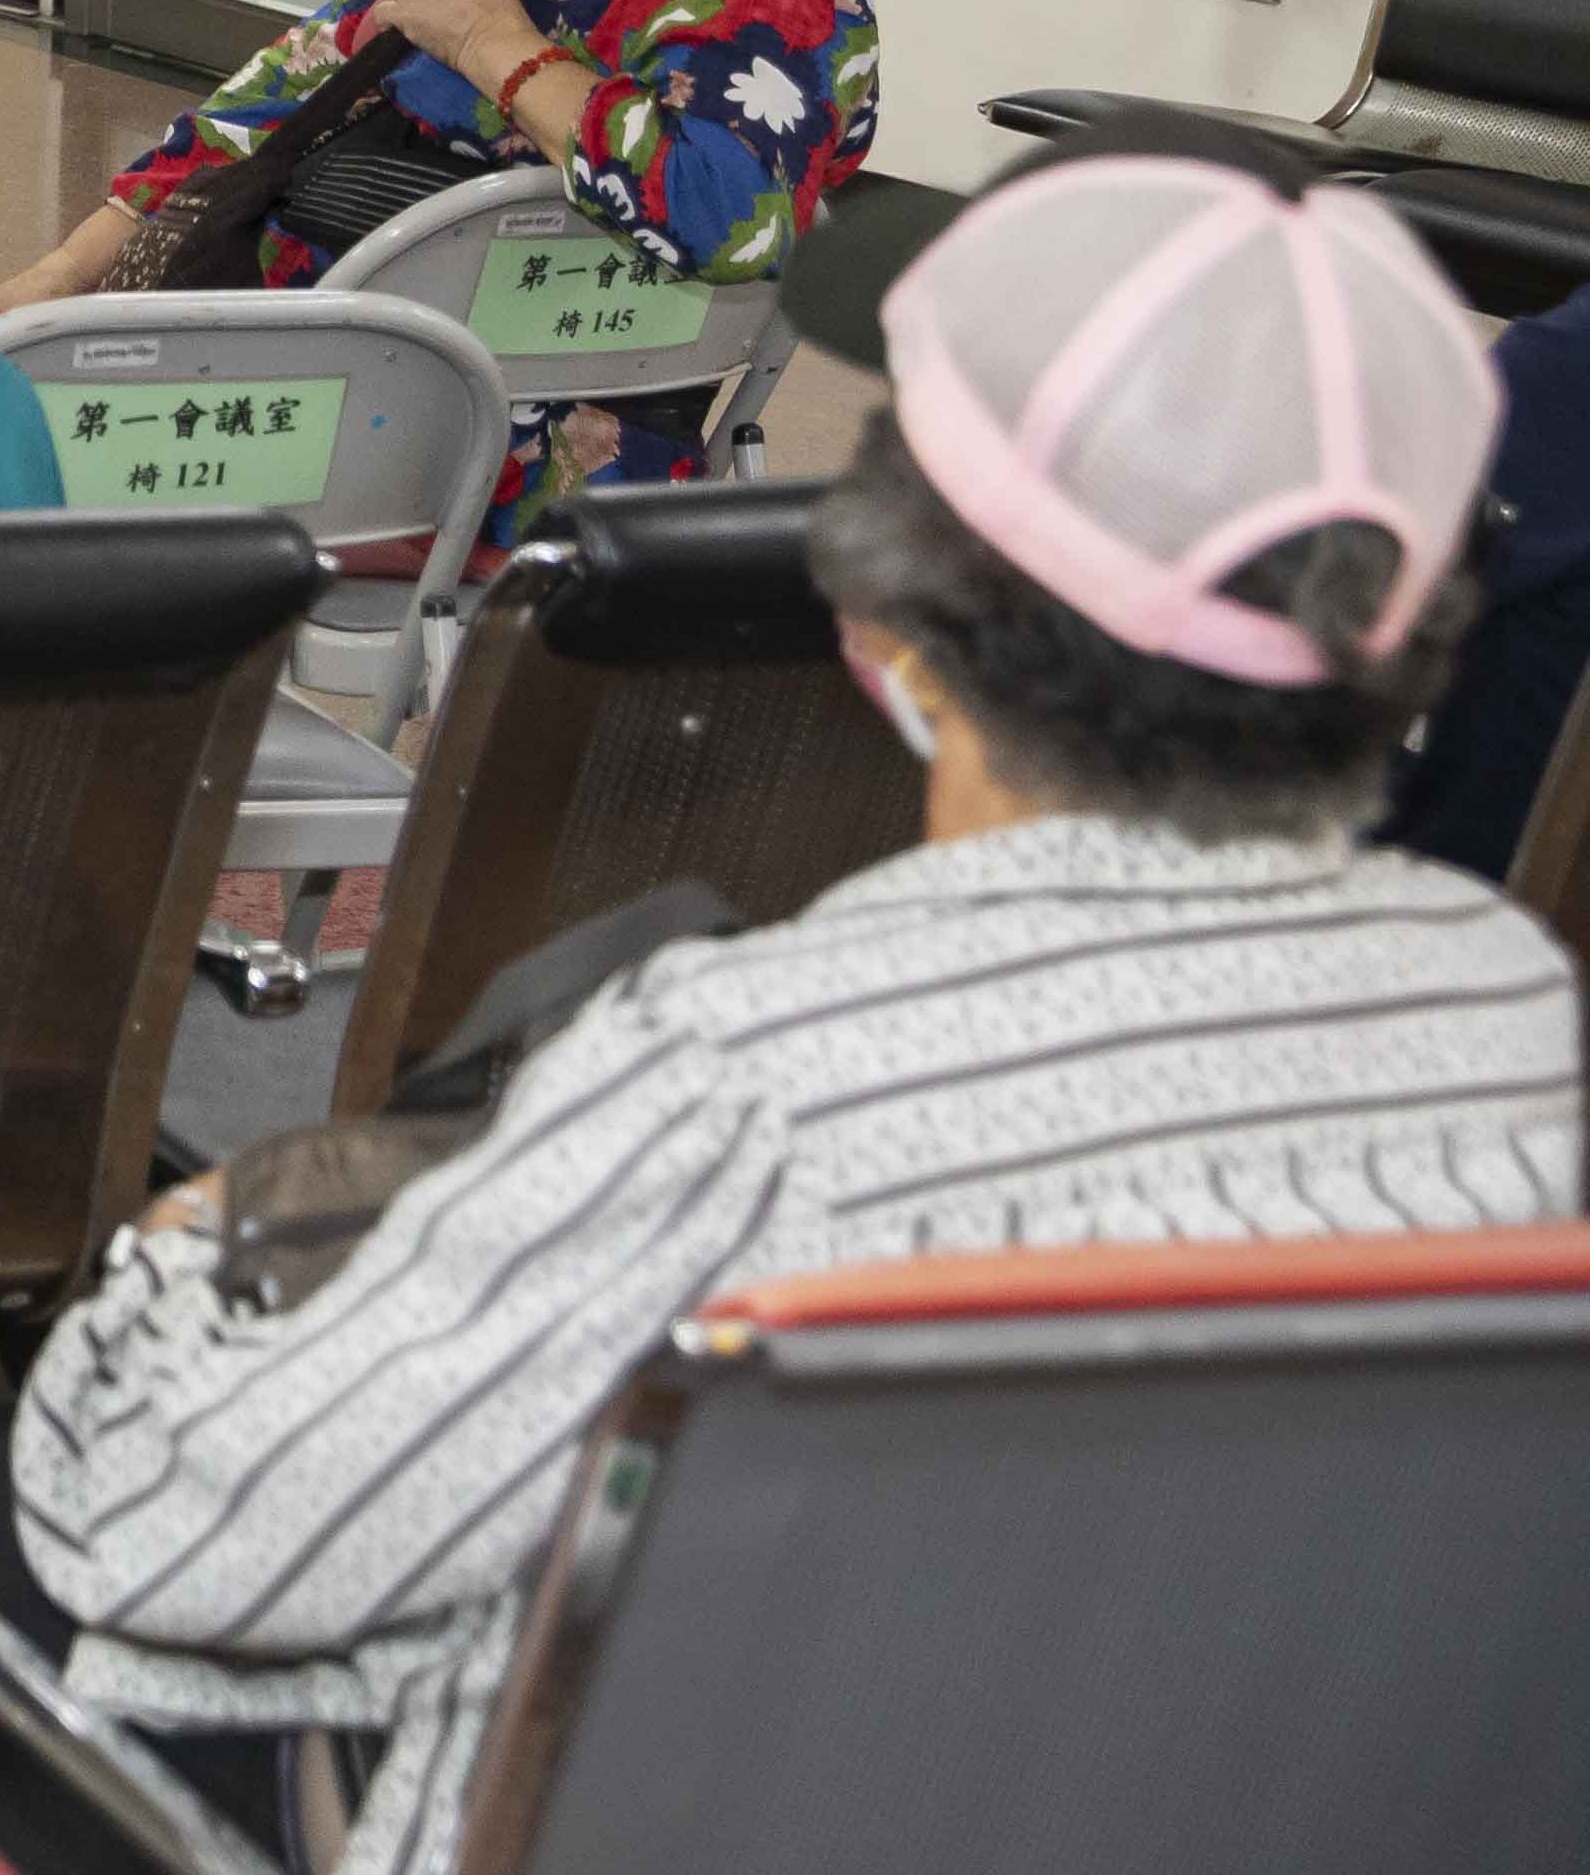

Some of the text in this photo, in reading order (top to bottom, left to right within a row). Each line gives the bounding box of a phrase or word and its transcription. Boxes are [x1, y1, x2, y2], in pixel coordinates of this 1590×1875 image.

[516, 254, 688, 291] 第一會議
[553, 309, 637, 339] 椅 145
[69, 397, 302, 444] 第一會議室
[126, 462, 227, 494] 椅 121
